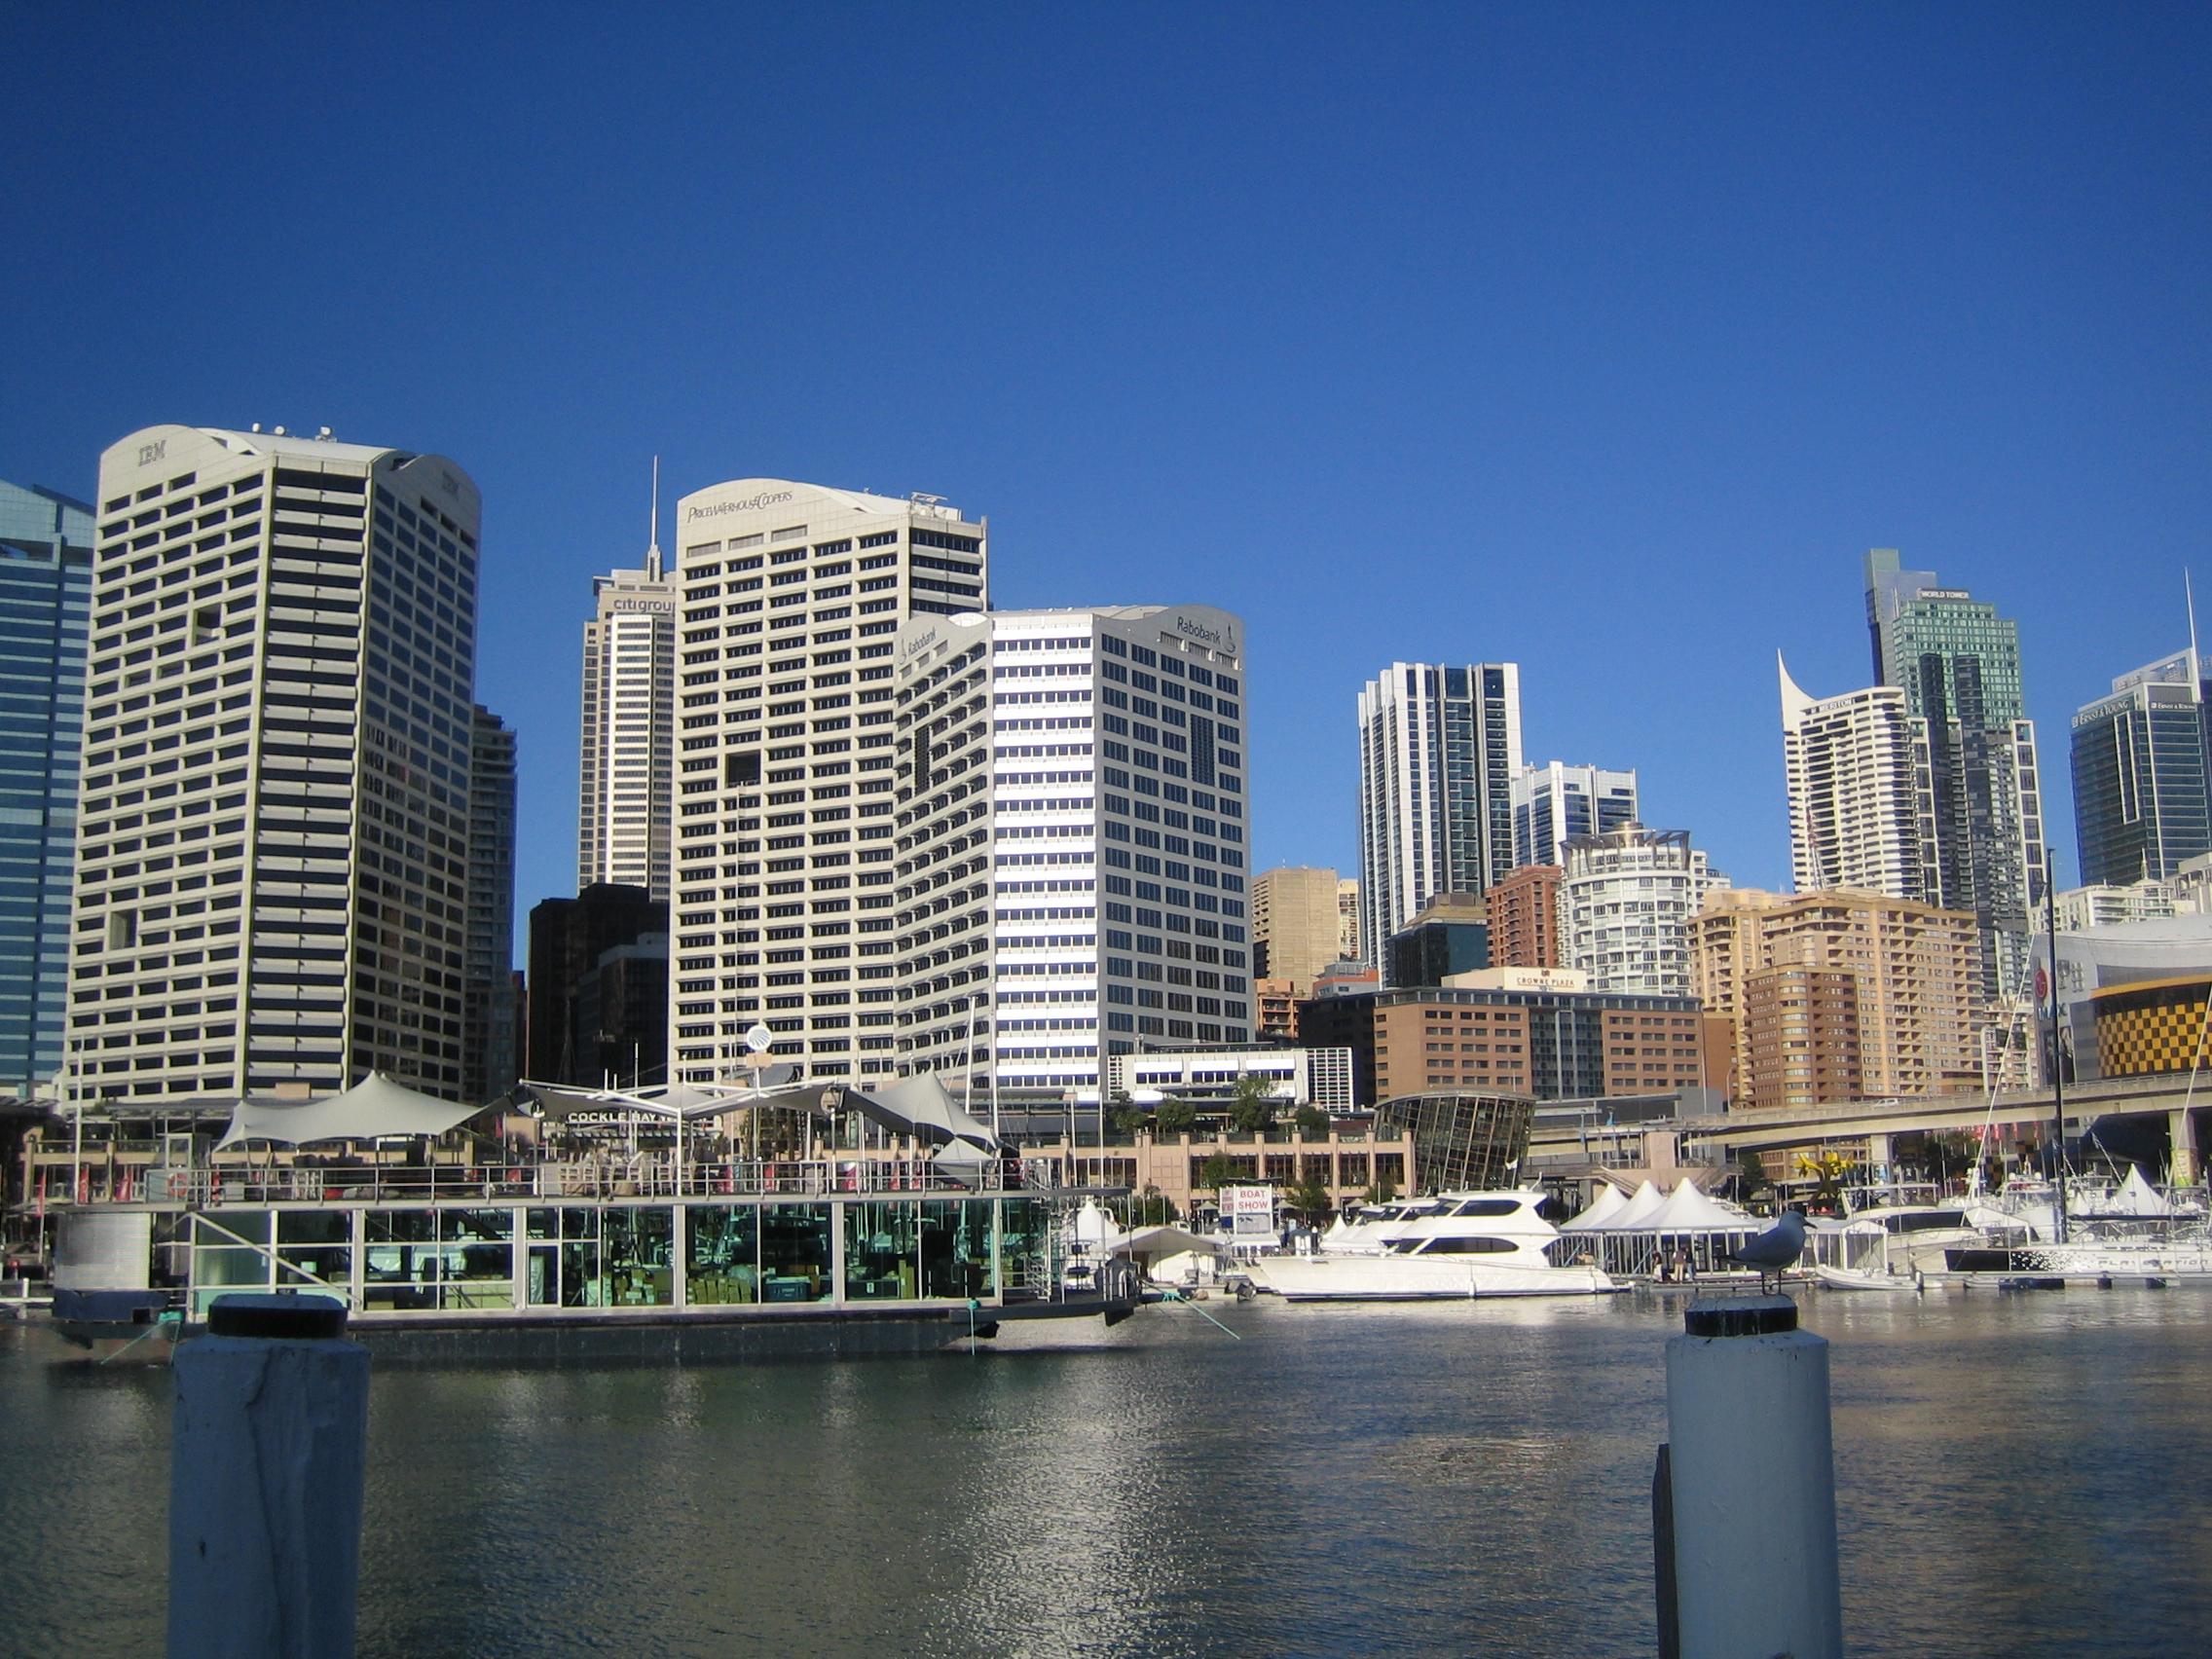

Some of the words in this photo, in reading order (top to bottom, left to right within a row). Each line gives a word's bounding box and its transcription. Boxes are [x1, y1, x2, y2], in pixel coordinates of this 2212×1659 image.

[138, 439, 166, 467] IBM
[1177, 616, 1221, 645] Rabobank
[568, 1112, 627, 1123] COCKLE
[632, 1111, 656, 1122] BAY
[1239, 1190, 1266, 1198] BOAT
[1238, 1200, 1269, 1209] SHOW
